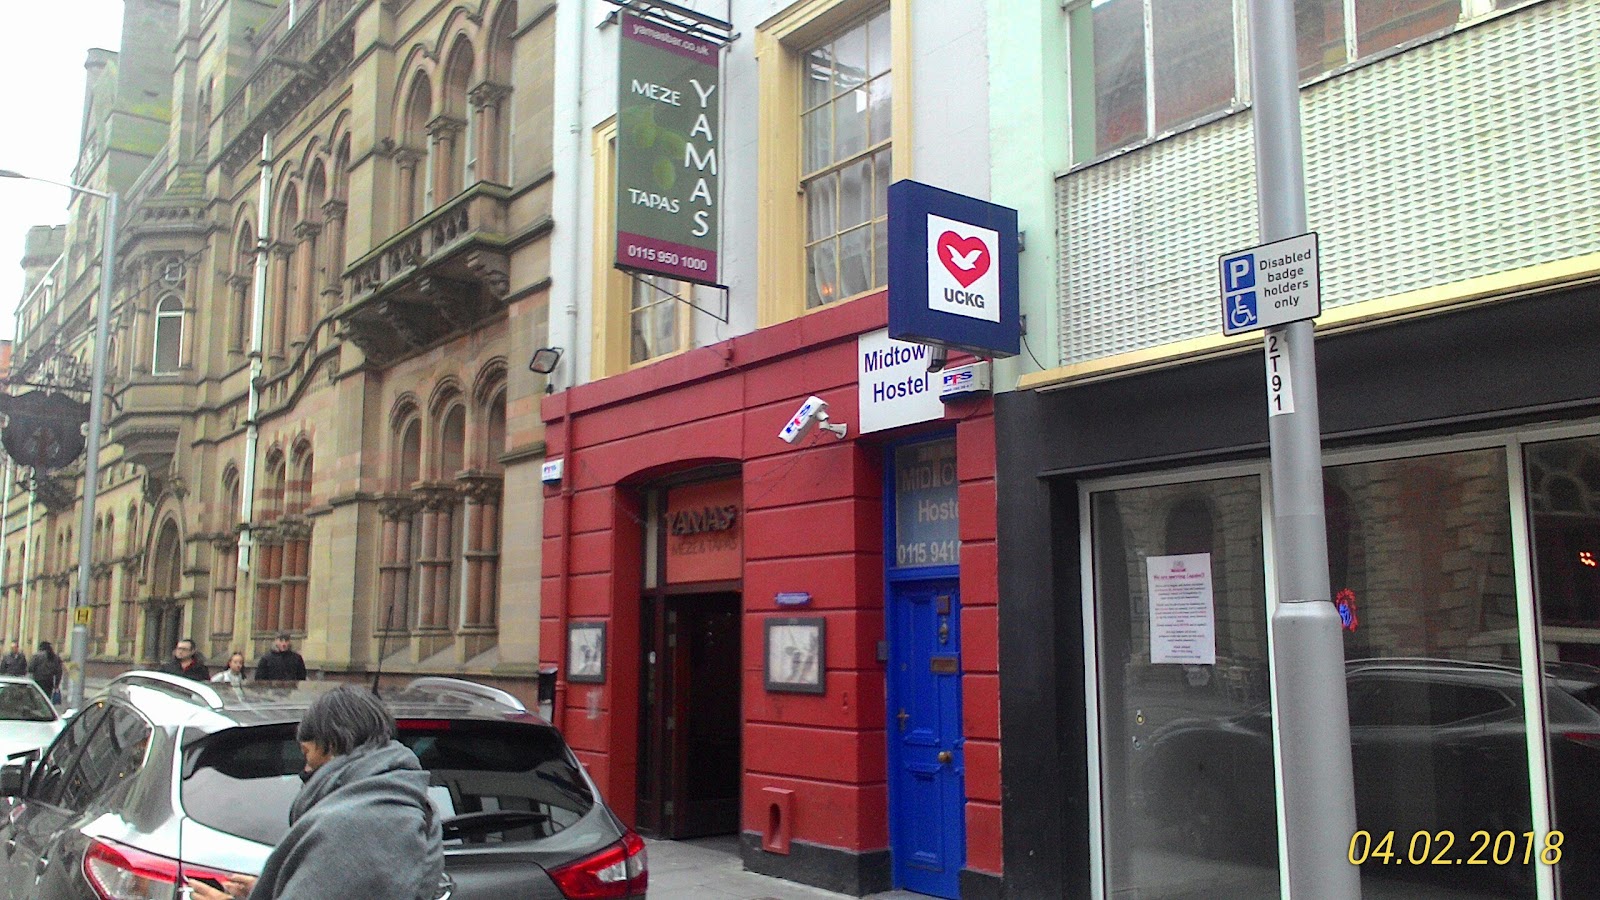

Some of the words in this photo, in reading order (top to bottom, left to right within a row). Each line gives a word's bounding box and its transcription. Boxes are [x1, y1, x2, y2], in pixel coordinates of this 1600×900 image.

[632, 23, 709, 56] yamasbar.co.uk
[631, 79, 681, 107] MEZE
[684, 79, 717, 237] YAMAS
[628, 187, 680, 214] TAPAS
[628, 244, 656, 261] 0115
[657, 250, 679, 266] 950
[681, 256, 708, 271] 1000
[1259, 248, 1311, 271] Disabled
[1229, 260, 1249, 289] P
[1267, 267, 1304, 283] badge
[943, 287, 985, 309] UCKG
[1264, 280, 1309, 298] holders
[1274, 295, 1300, 309] only
[873, 370, 929, 403] Hostel
[943, 370, 973, 385] PFS
[898, 542, 927, 564] 0115
